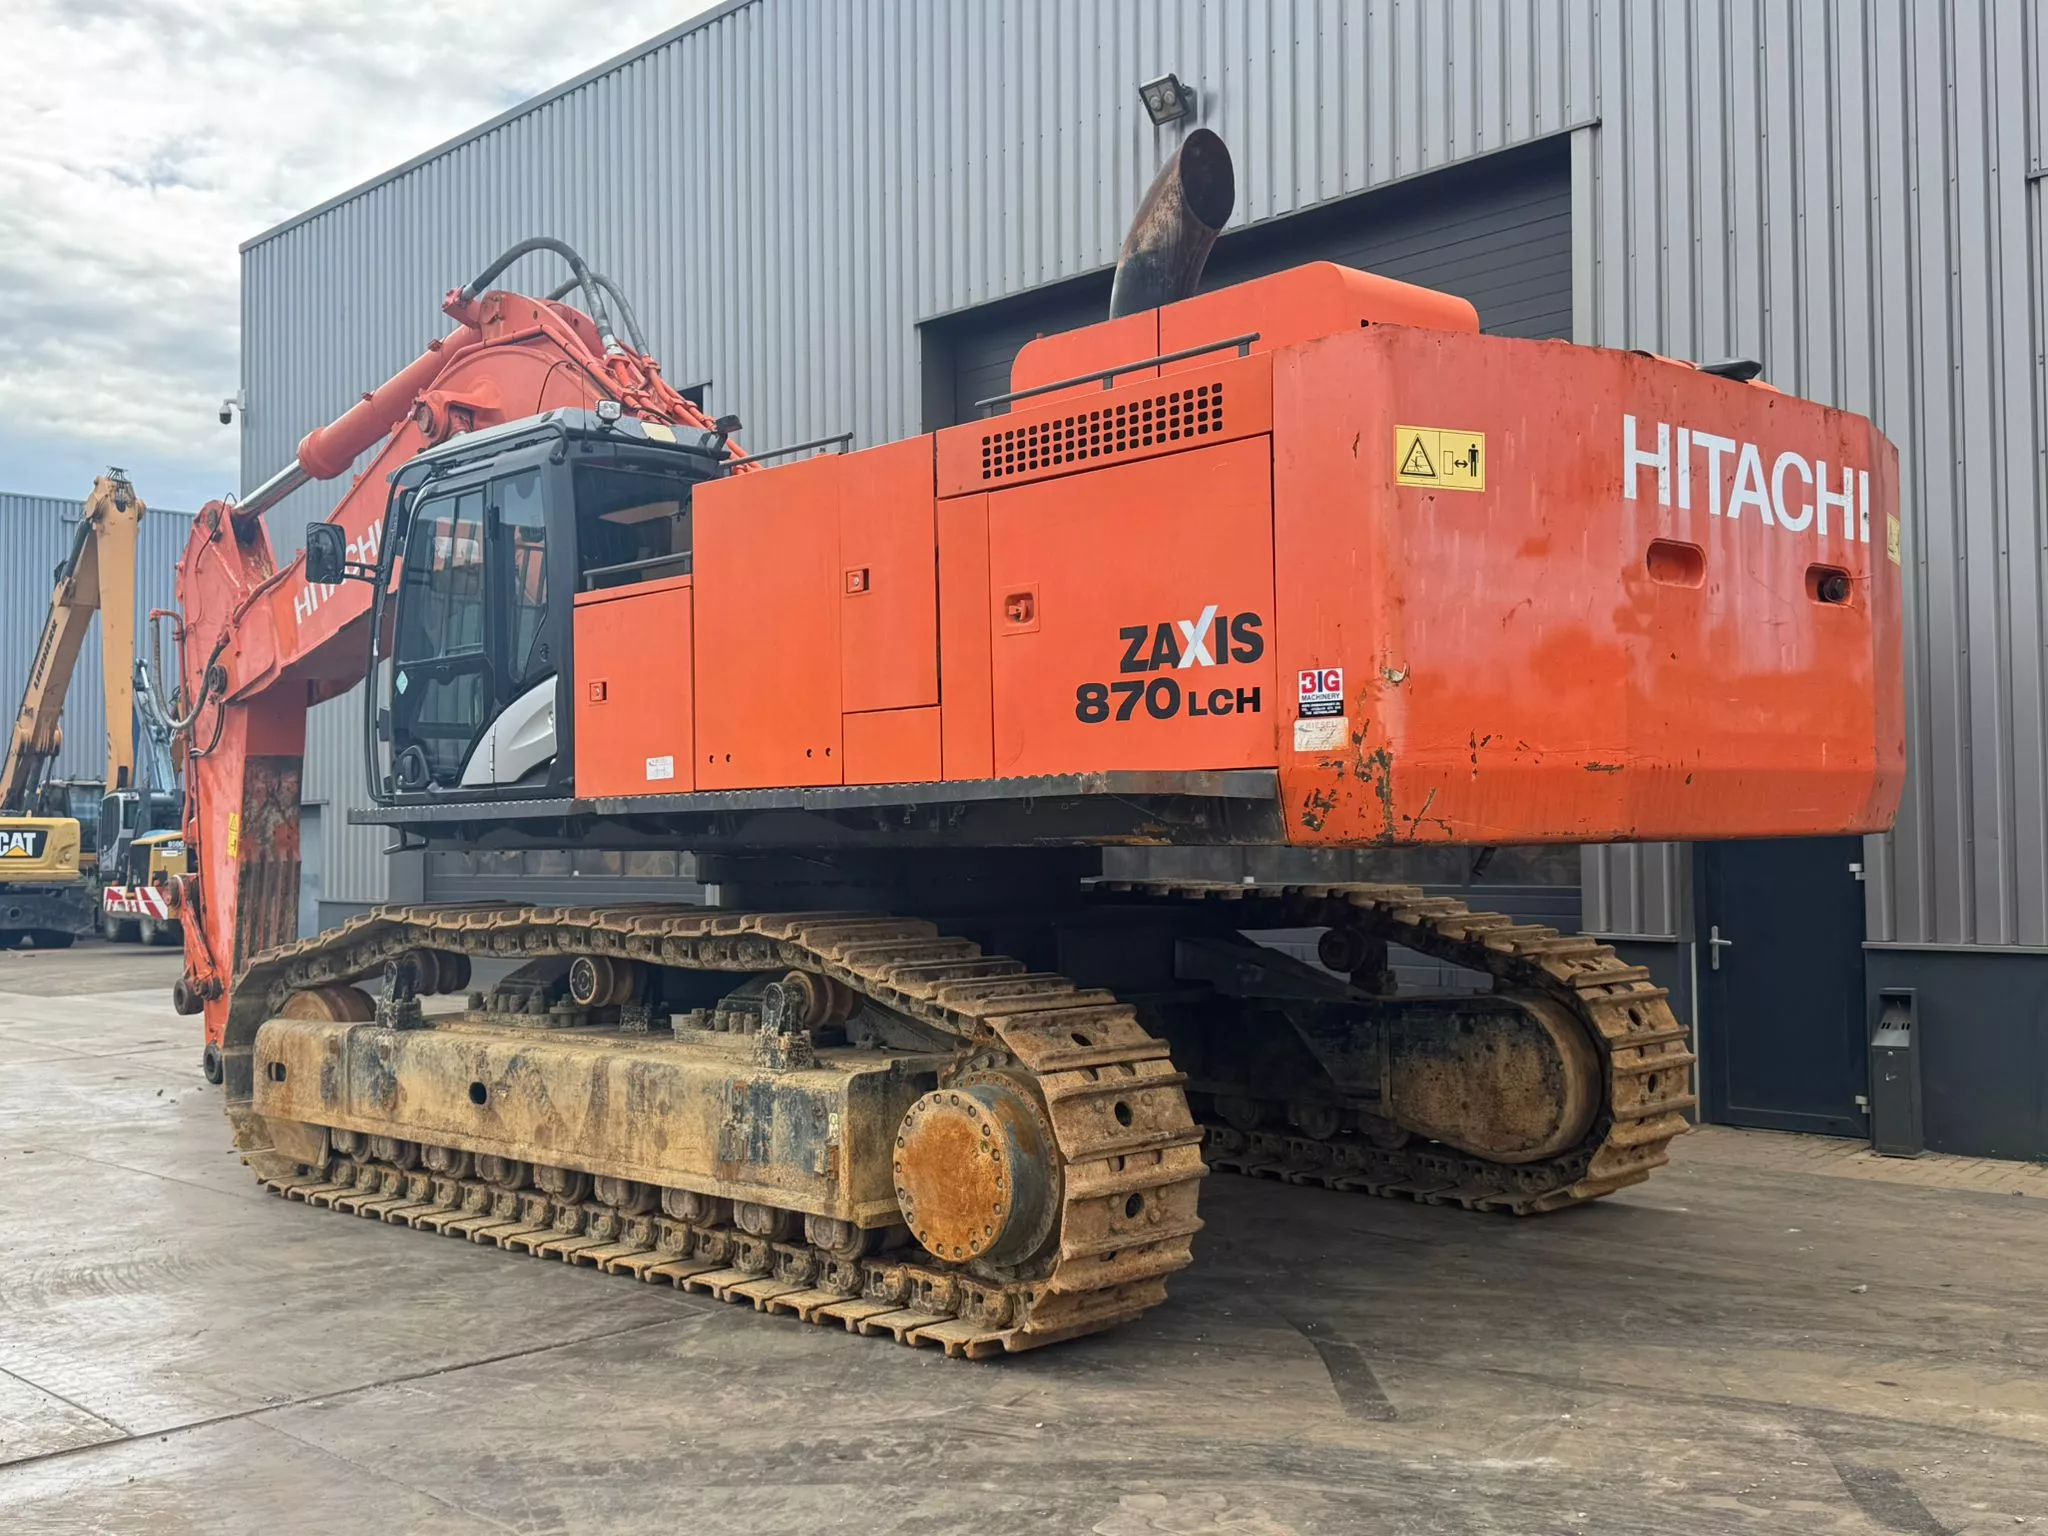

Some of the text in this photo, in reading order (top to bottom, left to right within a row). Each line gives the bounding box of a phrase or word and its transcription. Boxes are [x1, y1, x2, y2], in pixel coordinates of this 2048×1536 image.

[1624, 414, 1870, 543] HITACHI
[294, 518, 382, 624] HICHI
[1119, 604, 1265, 674] ZAXIS
[1075, 677, 1261, 724] 870 LCH
[1301, 692, 1340, 701] MACHINERY
[0, 832, 37, 857] CAT
